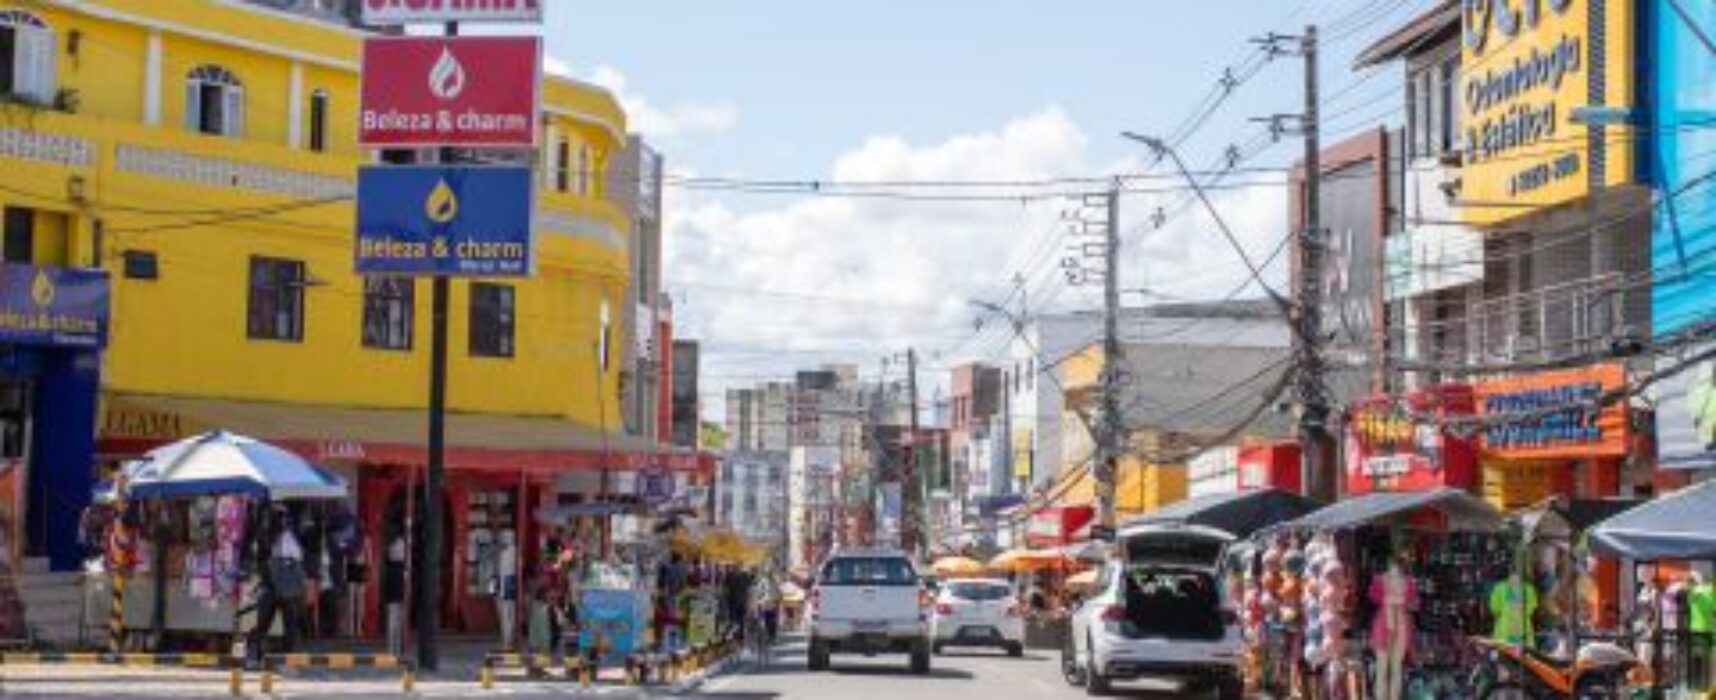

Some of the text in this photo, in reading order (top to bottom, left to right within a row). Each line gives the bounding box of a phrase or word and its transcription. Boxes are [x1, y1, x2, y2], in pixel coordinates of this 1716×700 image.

[364, 107, 525, 131] Beleza & charm
[359, 235, 523, 259] Beleza & charm
